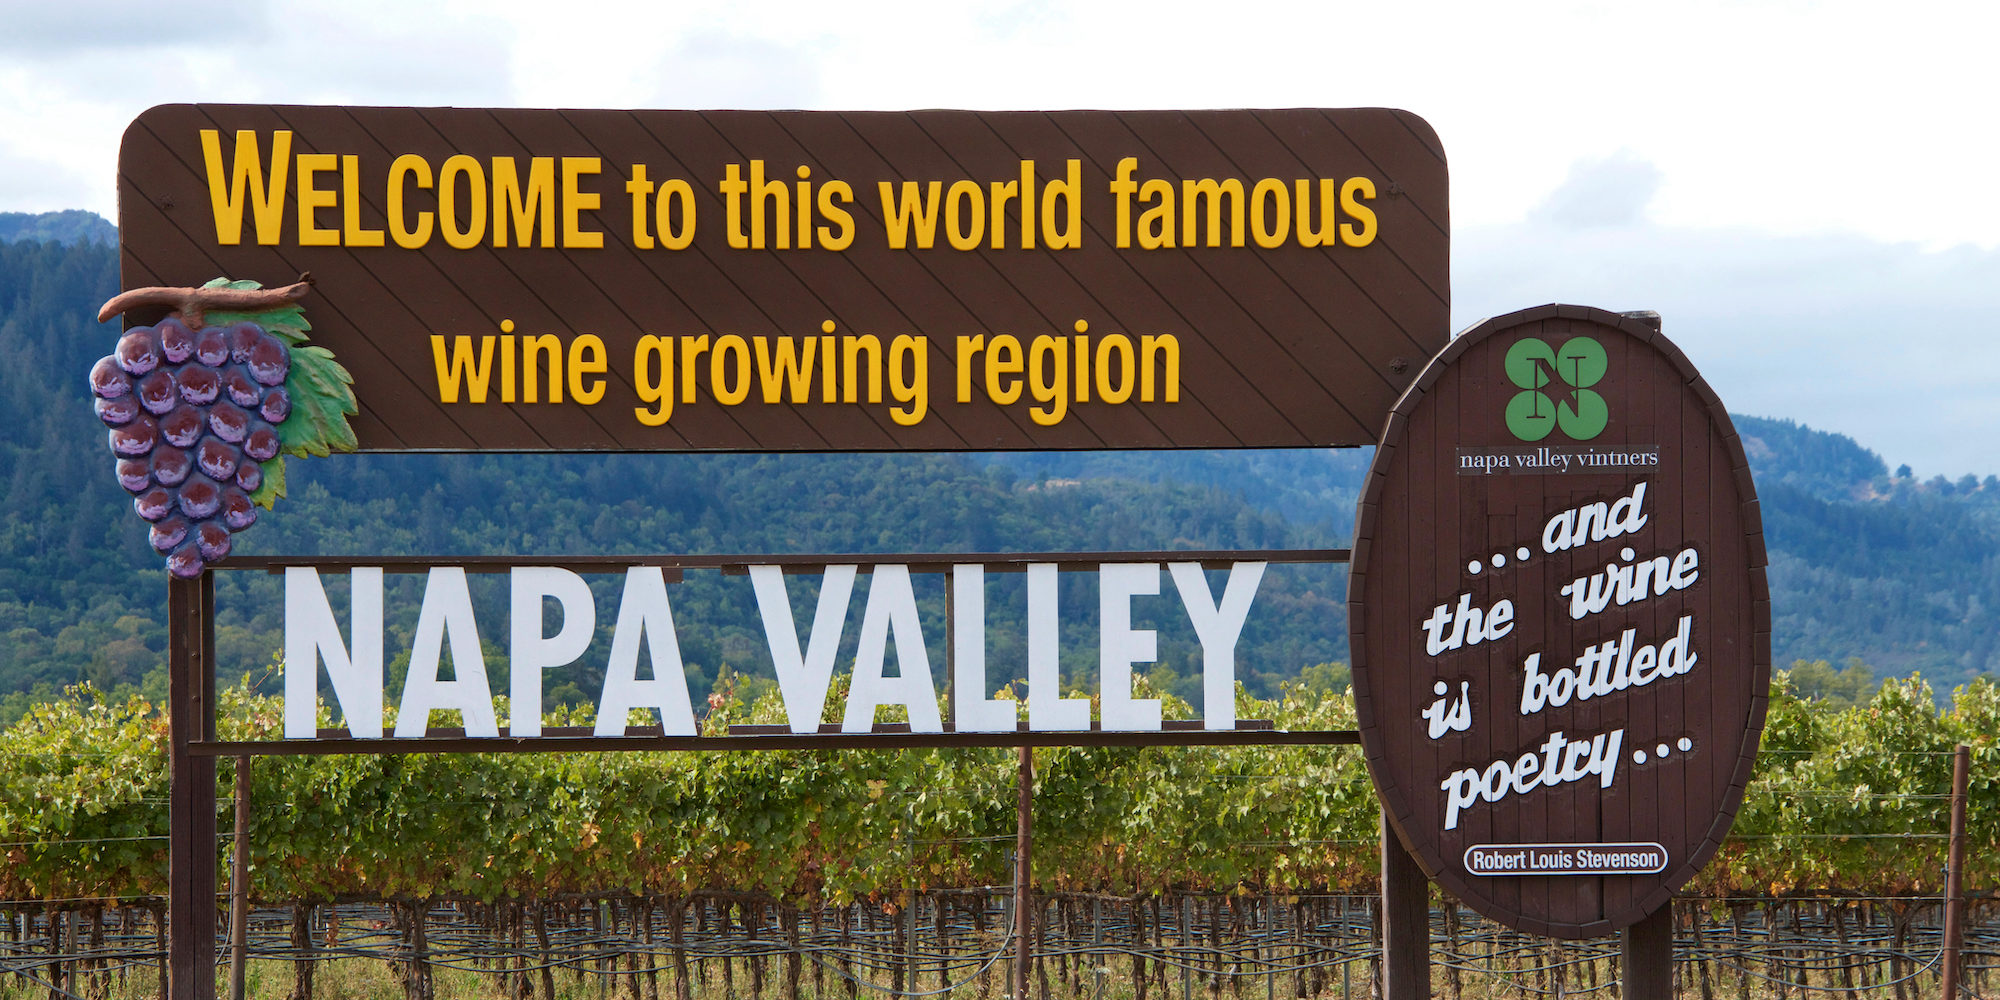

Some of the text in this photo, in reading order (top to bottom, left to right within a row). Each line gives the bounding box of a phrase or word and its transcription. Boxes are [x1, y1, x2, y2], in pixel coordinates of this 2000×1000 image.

[200, 129, 1378, 251] WELCOME to this world famous
[430, 319, 1180, 426] wine growing region
[1459, 448, 1658, 474] napa valley vintners
[284, 561, 1267, 739] NAPA VALLEY
[1422, 547, 1700, 657] the wine
[1421, 615, 1698, 740] is bottled
[1473, 848, 1660, 870] Robert Louis Stevenson
